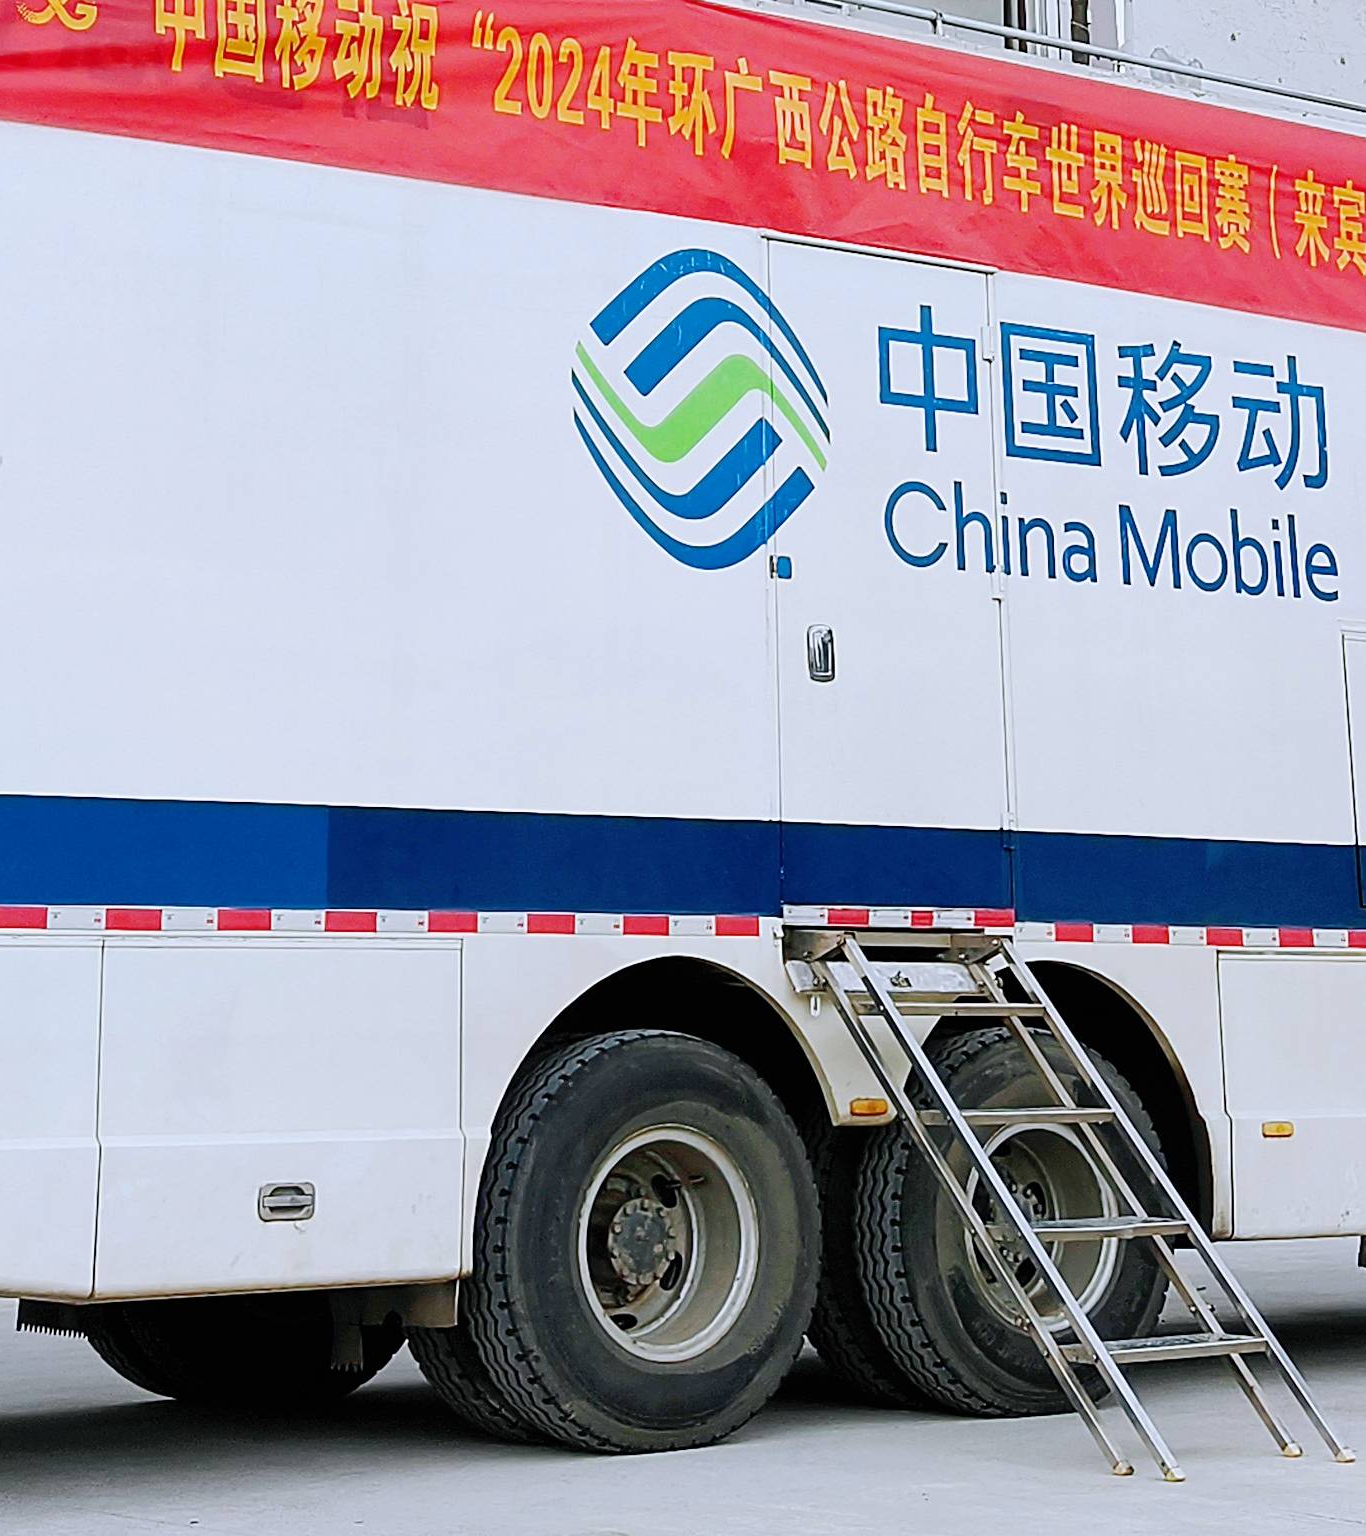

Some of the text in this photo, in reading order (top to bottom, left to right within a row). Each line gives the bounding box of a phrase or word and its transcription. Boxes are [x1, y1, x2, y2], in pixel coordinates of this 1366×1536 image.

[878, 304, 1328, 492] 中国移动
[884, 480, 1340, 603] China Mobile
